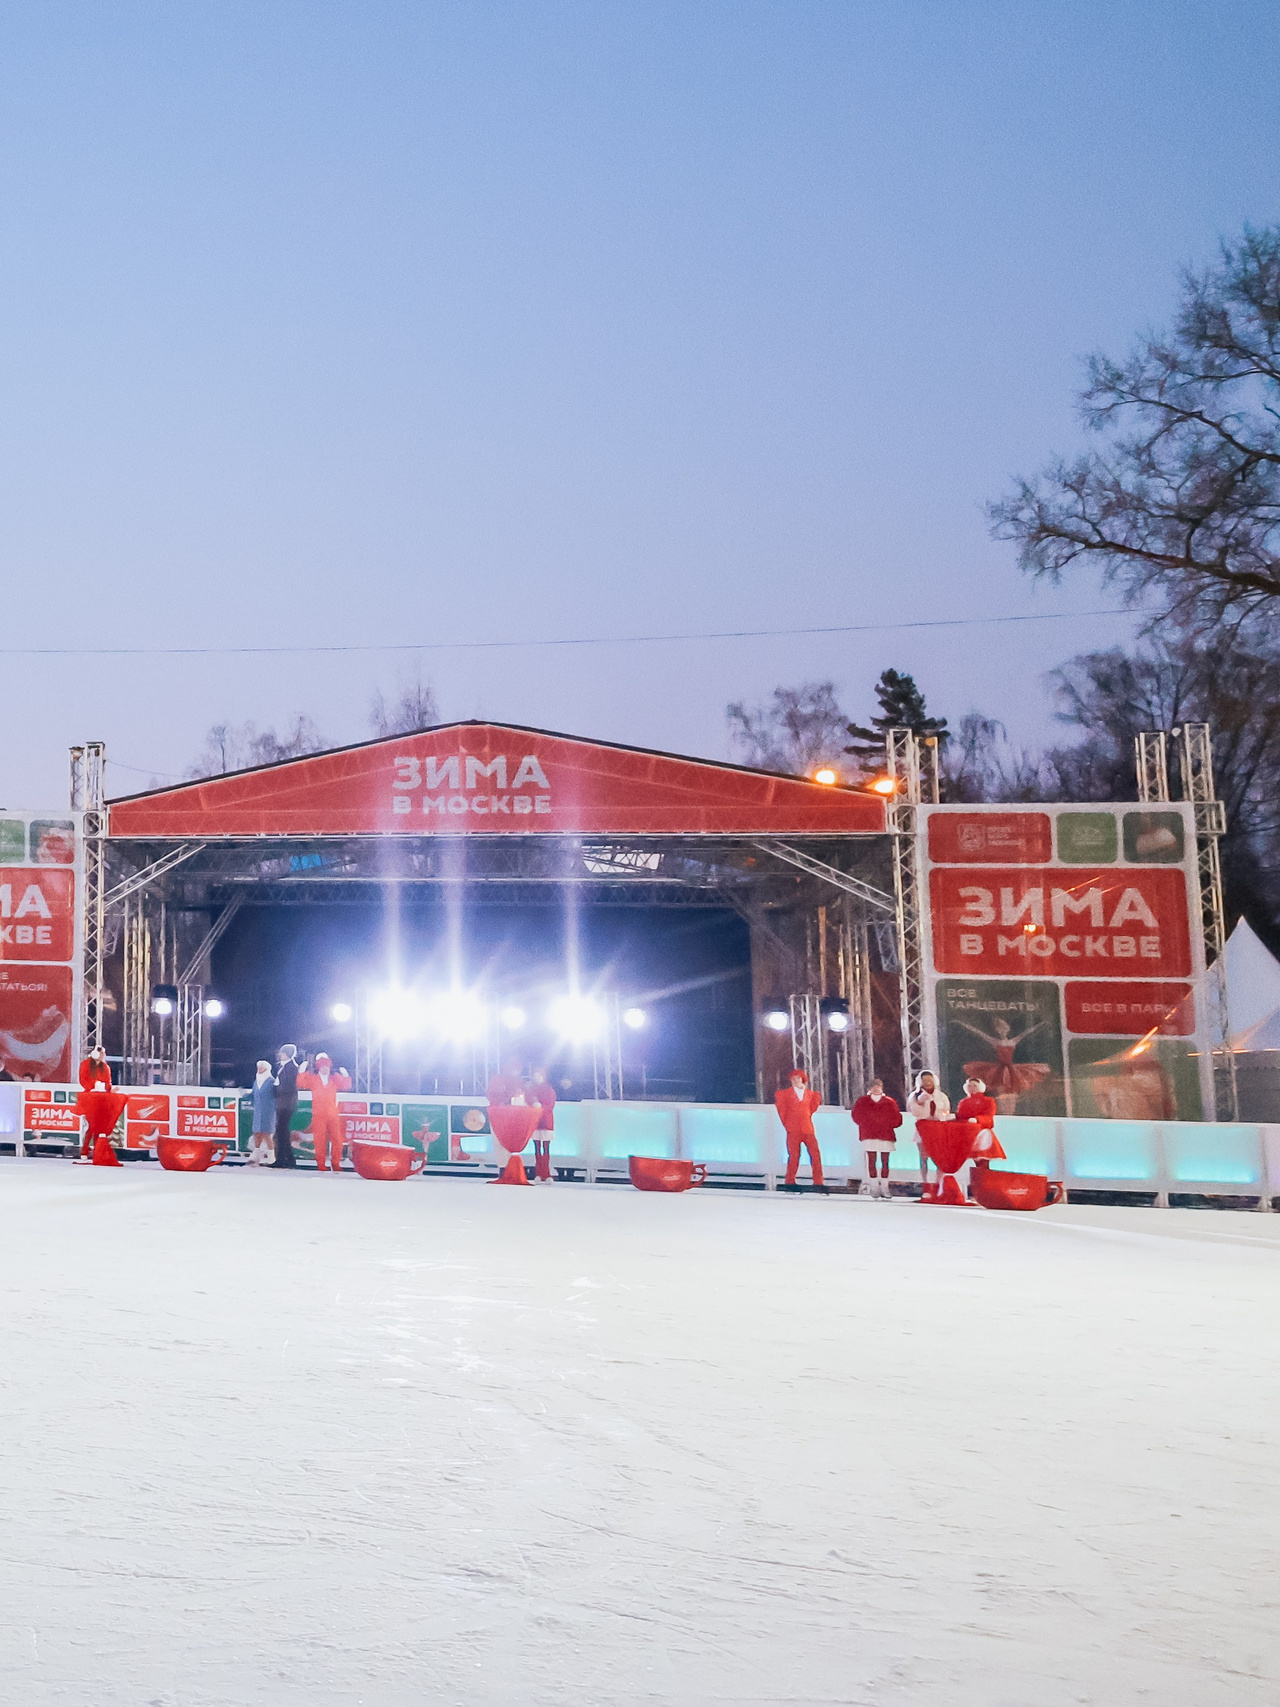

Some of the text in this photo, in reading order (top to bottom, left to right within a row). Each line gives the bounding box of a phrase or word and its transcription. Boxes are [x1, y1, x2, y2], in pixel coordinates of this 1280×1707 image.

[392, 755, 551, 790] ЗИМА
[392, 796, 551, 815] В МОСКВЕ
[958, 886, 1160, 928] ЗИМА
[960, 934, 1161, 959] В МОСКВЕ
[947, 988, 978, 998] ВСЕ
[1082, 1003, 1113, 1013] ВСЕ
[31, 1108, 74, 1120] ЗИМА
[184, 1114, 229, 1126] ЗИМА
[346, 1120, 392, 1133] ЗИМА
